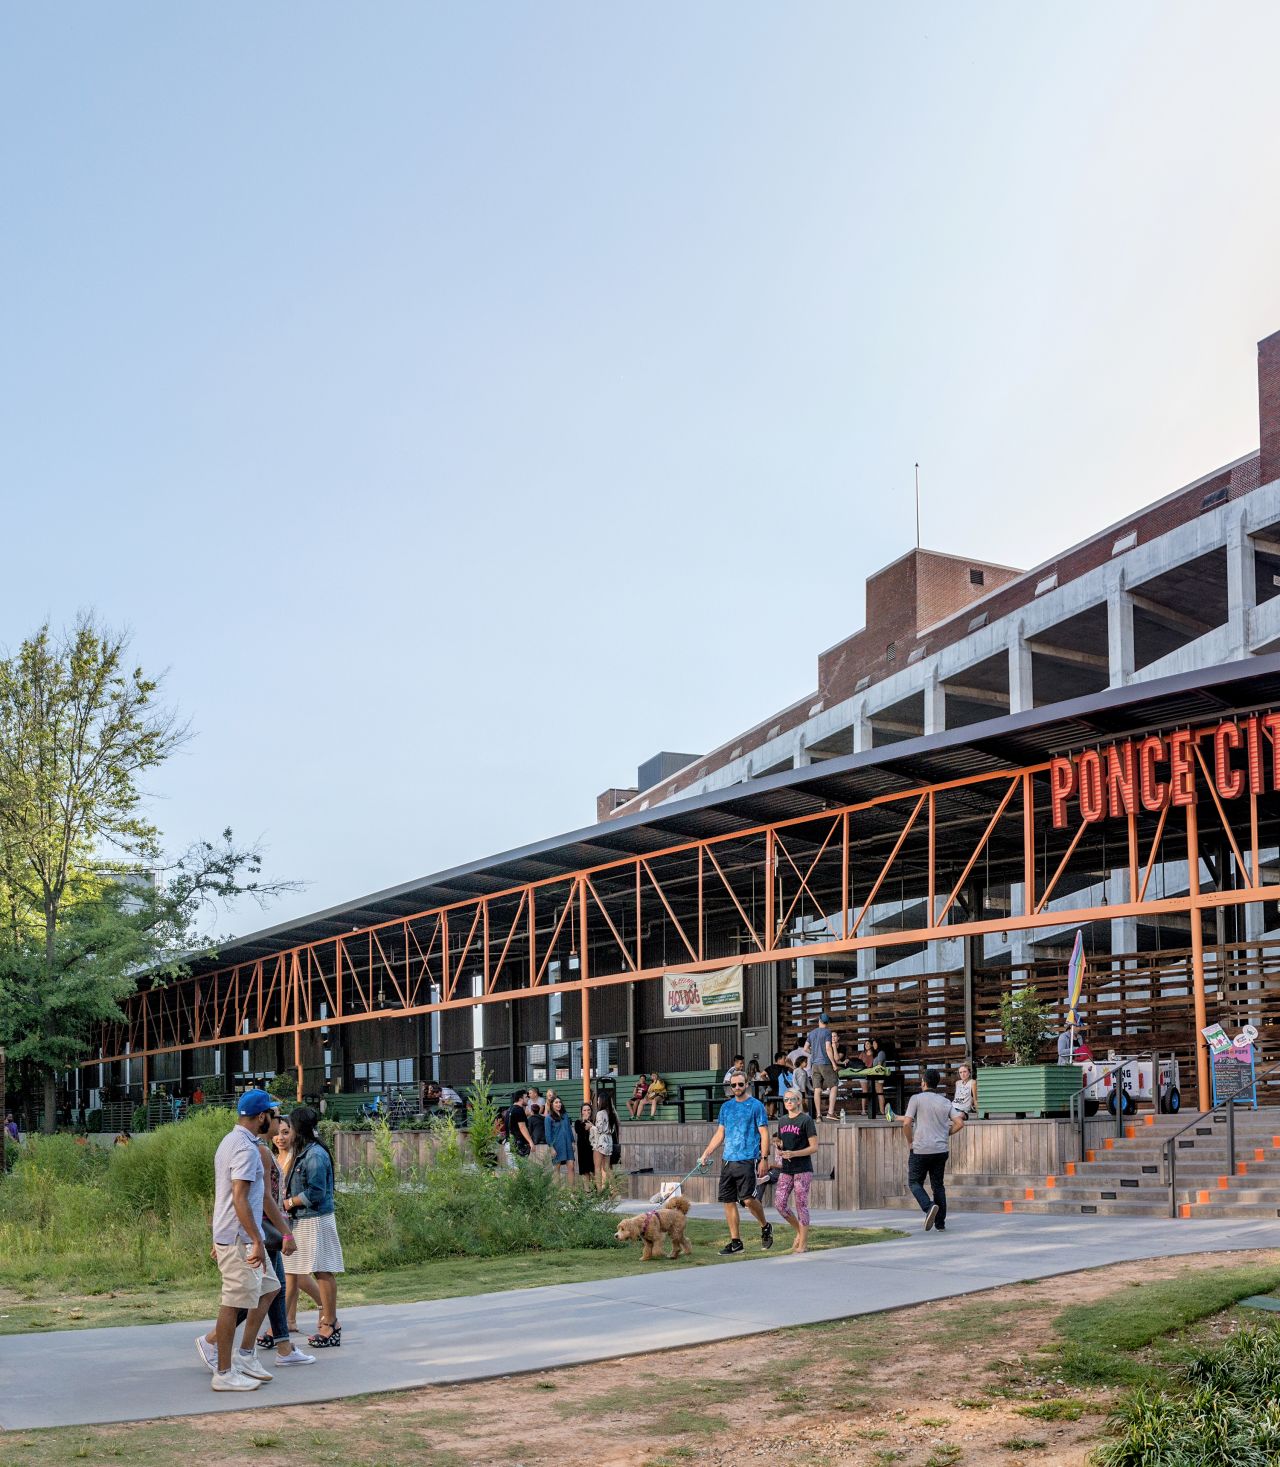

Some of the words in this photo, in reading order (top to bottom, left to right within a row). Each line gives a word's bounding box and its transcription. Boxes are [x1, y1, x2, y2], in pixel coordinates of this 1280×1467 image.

[1050, 729, 1197, 828] PONCE
[1112, 1069, 1131, 1078] KNG
[1112, 1082, 1133, 1090] PPS
[779, 1124, 801, 1135] MIAMI
